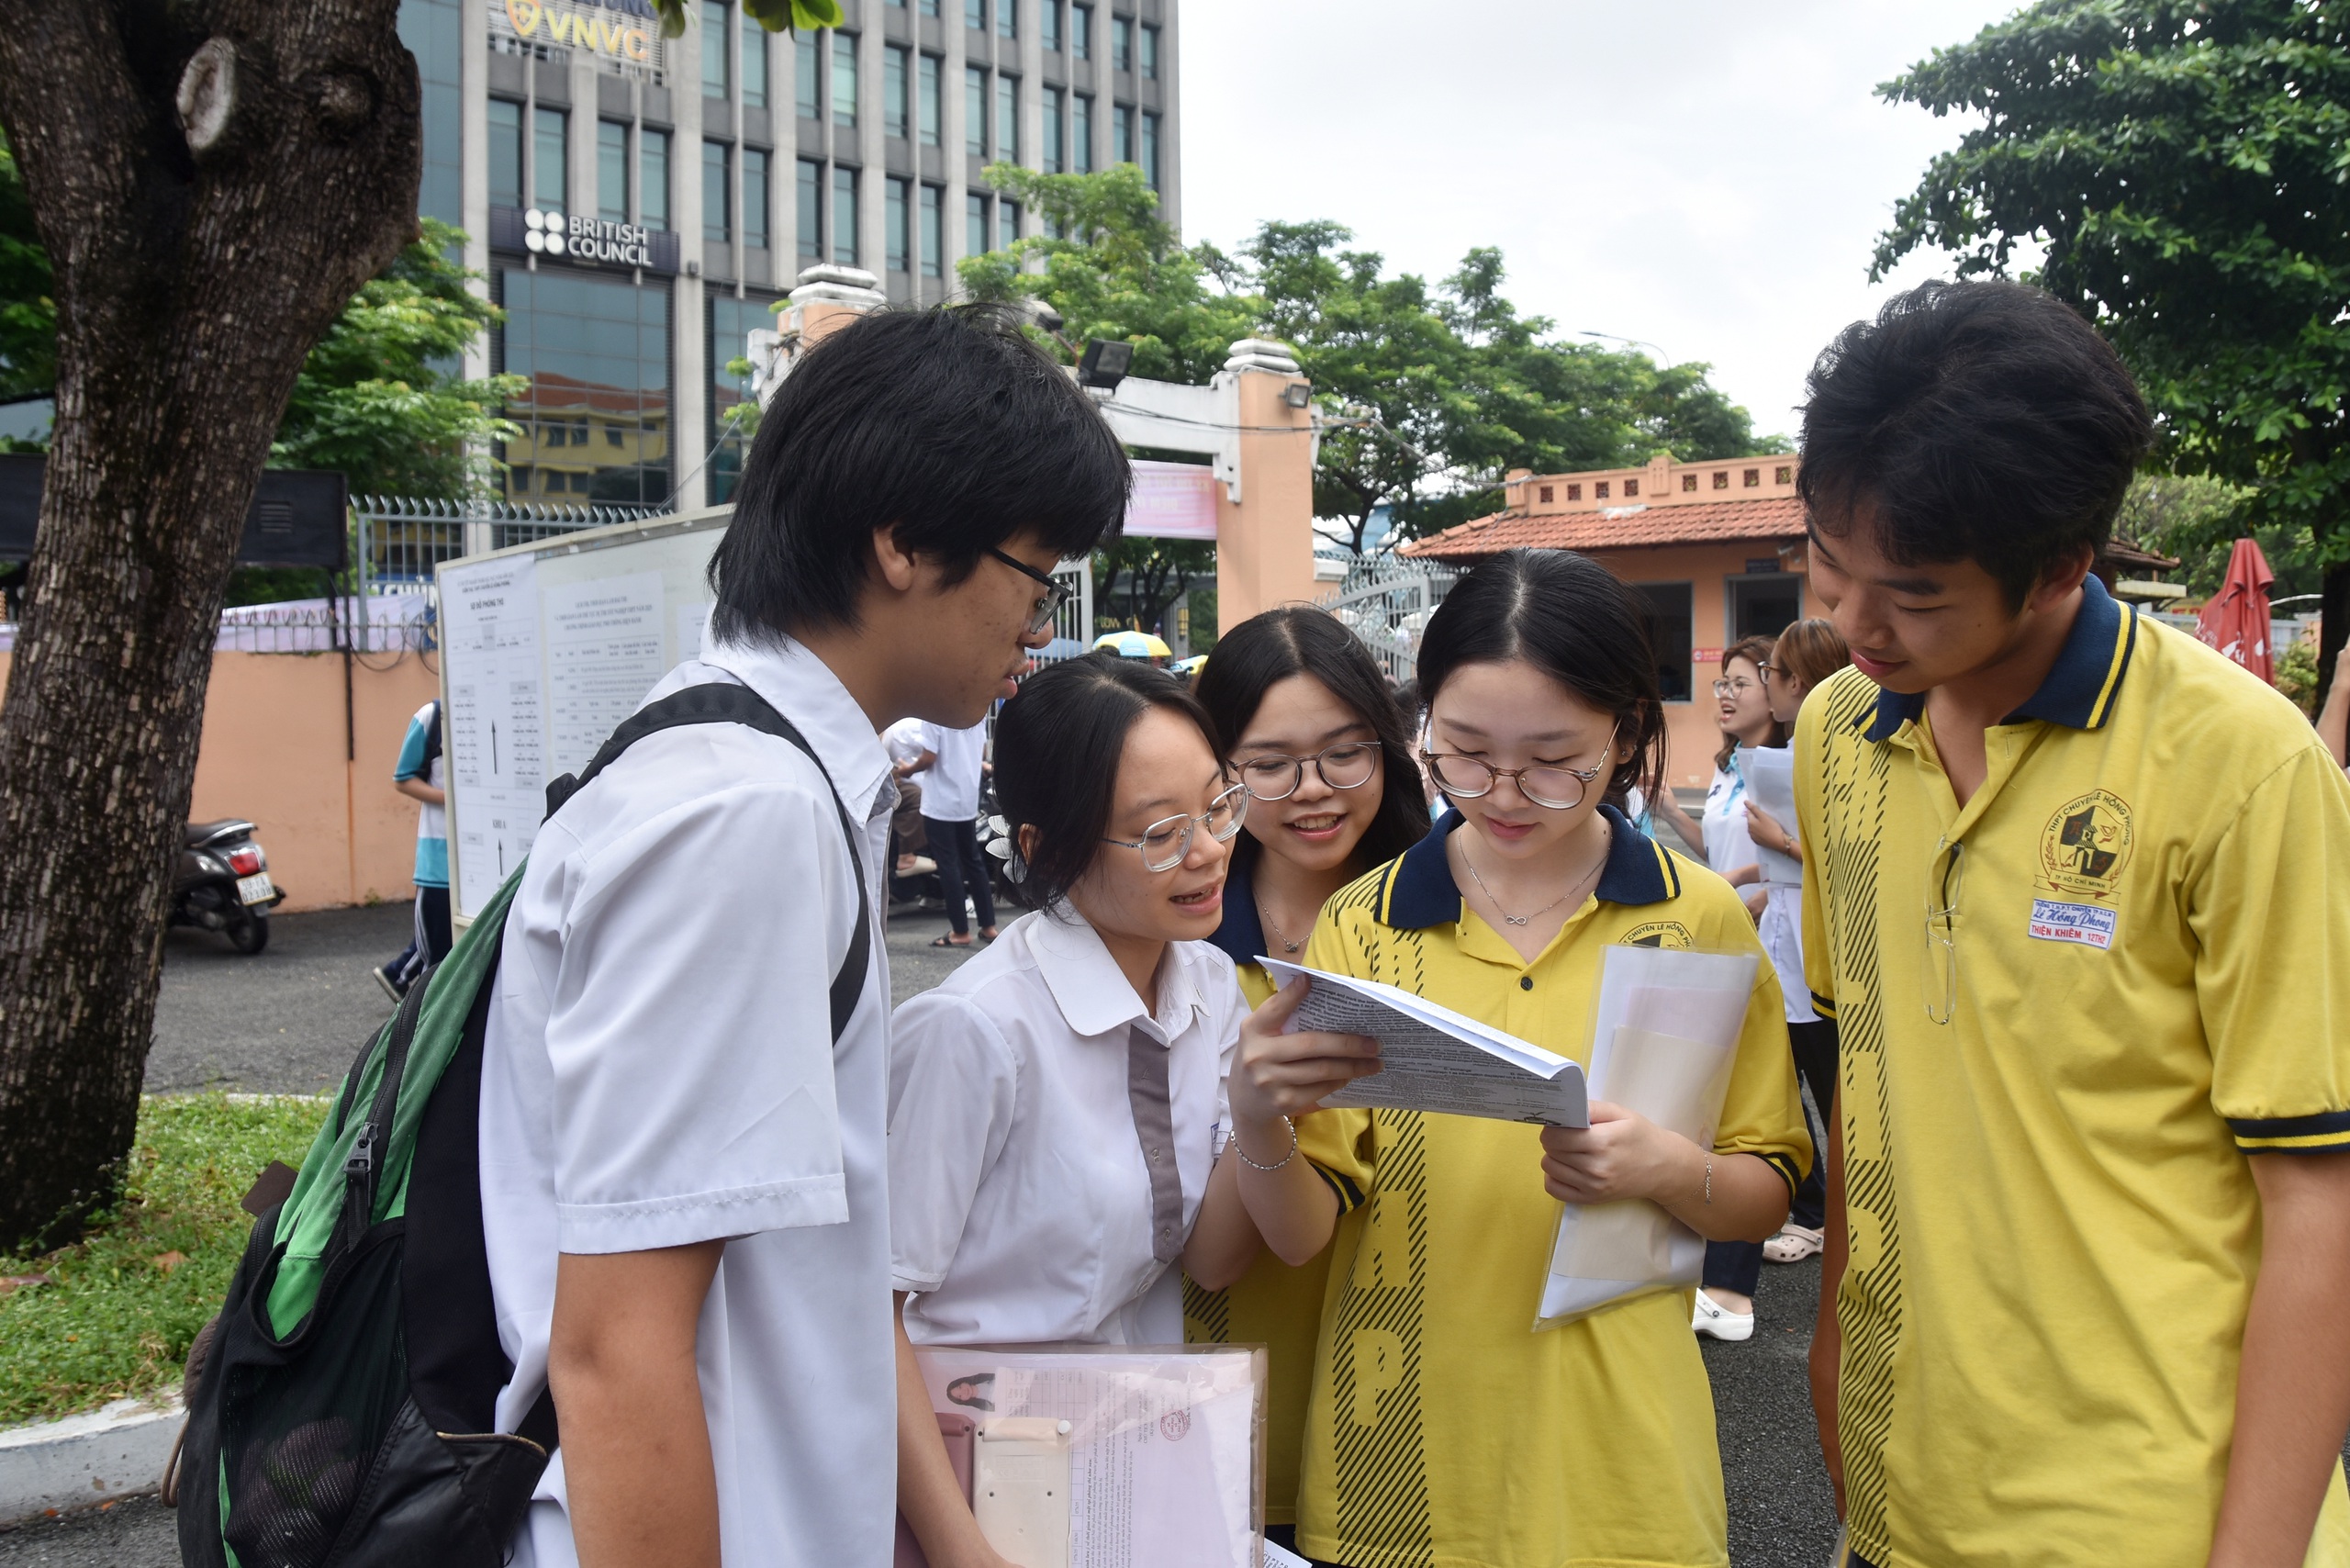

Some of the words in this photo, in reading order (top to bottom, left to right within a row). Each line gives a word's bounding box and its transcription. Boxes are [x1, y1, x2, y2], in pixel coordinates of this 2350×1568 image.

[544, 7, 648, 61] VNVC
[569, 216, 648, 245] BRITISH
[567, 236, 654, 267] COUNCIL
[2048, 814, 2064, 832] THPT
[2093, 791, 2102, 801] LÊ
[2102, 795, 2127, 815] HỒNG
[2088, 880, 2106, 889] MINH
[1628, 924, 1655, 941] CHUYÊN
[2031, 924, 2052, 936] THIỆN
[2054, 927, 2082, 939] KHIÊM
[2046, 909, 2077, 925] Hồng
[2078, 912, 2111, 932] Phong
